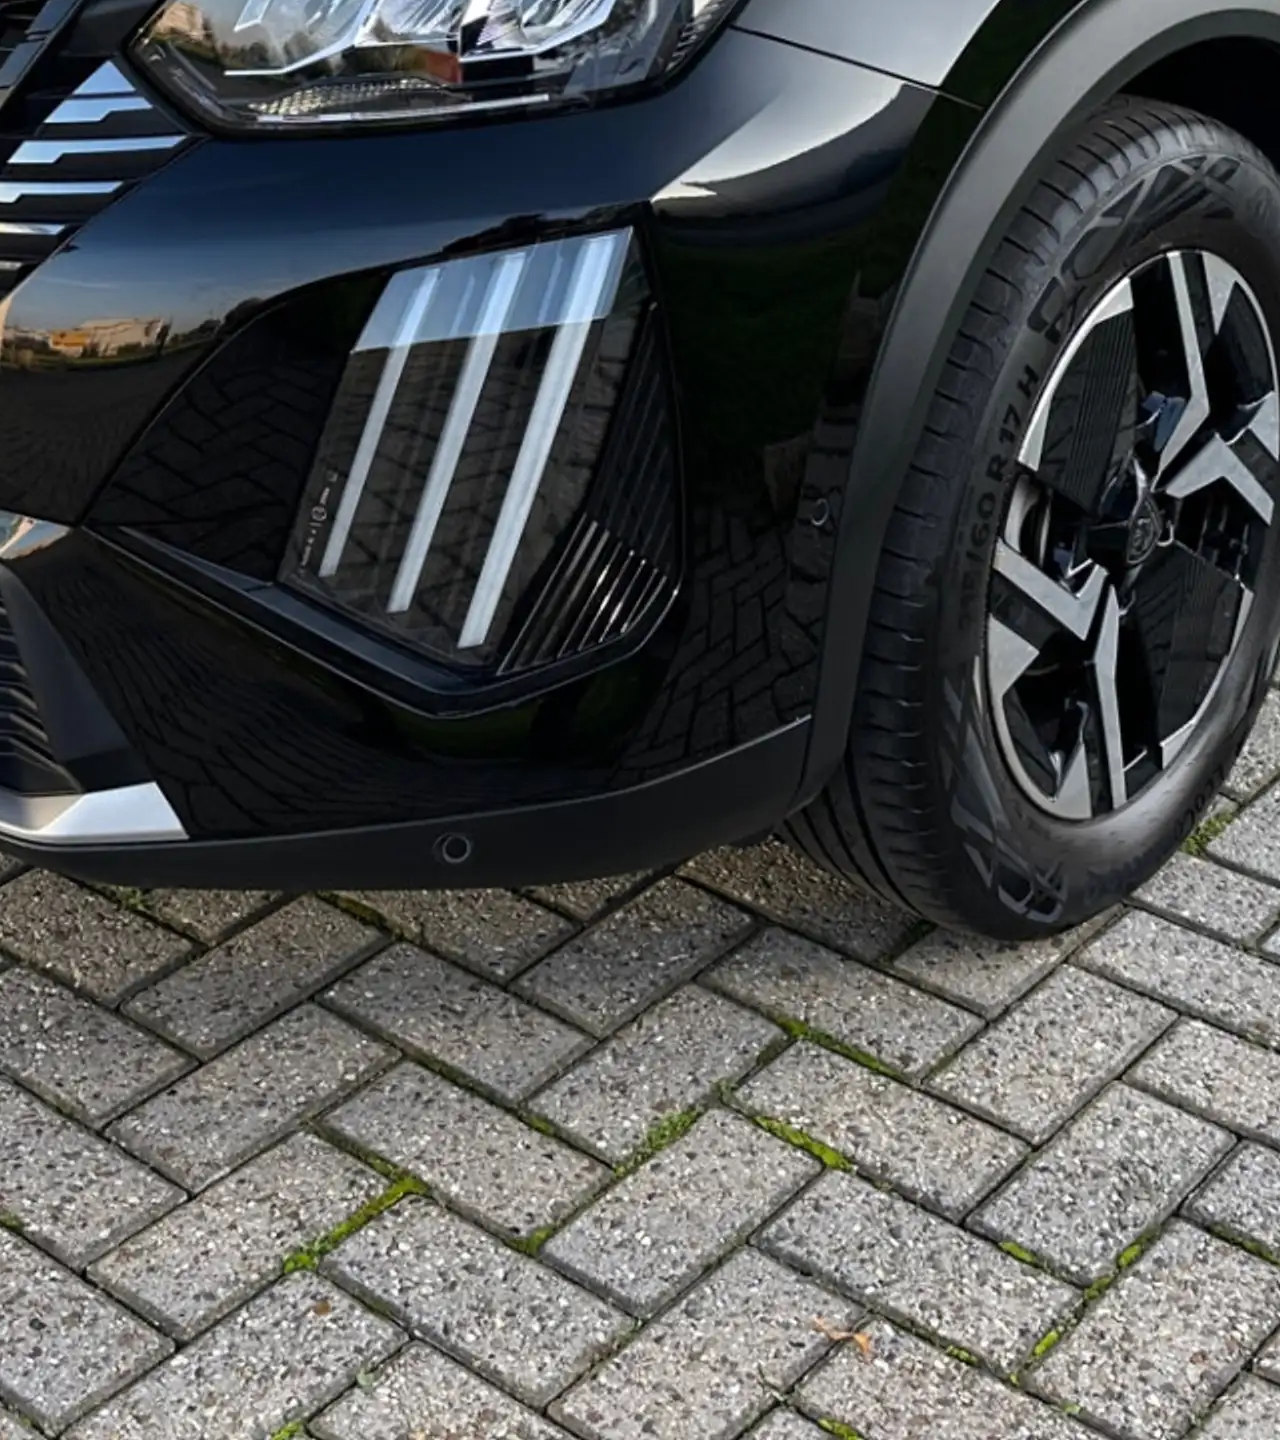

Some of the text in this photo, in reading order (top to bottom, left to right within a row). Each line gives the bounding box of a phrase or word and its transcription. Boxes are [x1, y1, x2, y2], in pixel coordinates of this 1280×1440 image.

[986, 453, 1009, 483] R
[998, 403, 1020, 447] 17
[1016, 364, 1040, 397] H
